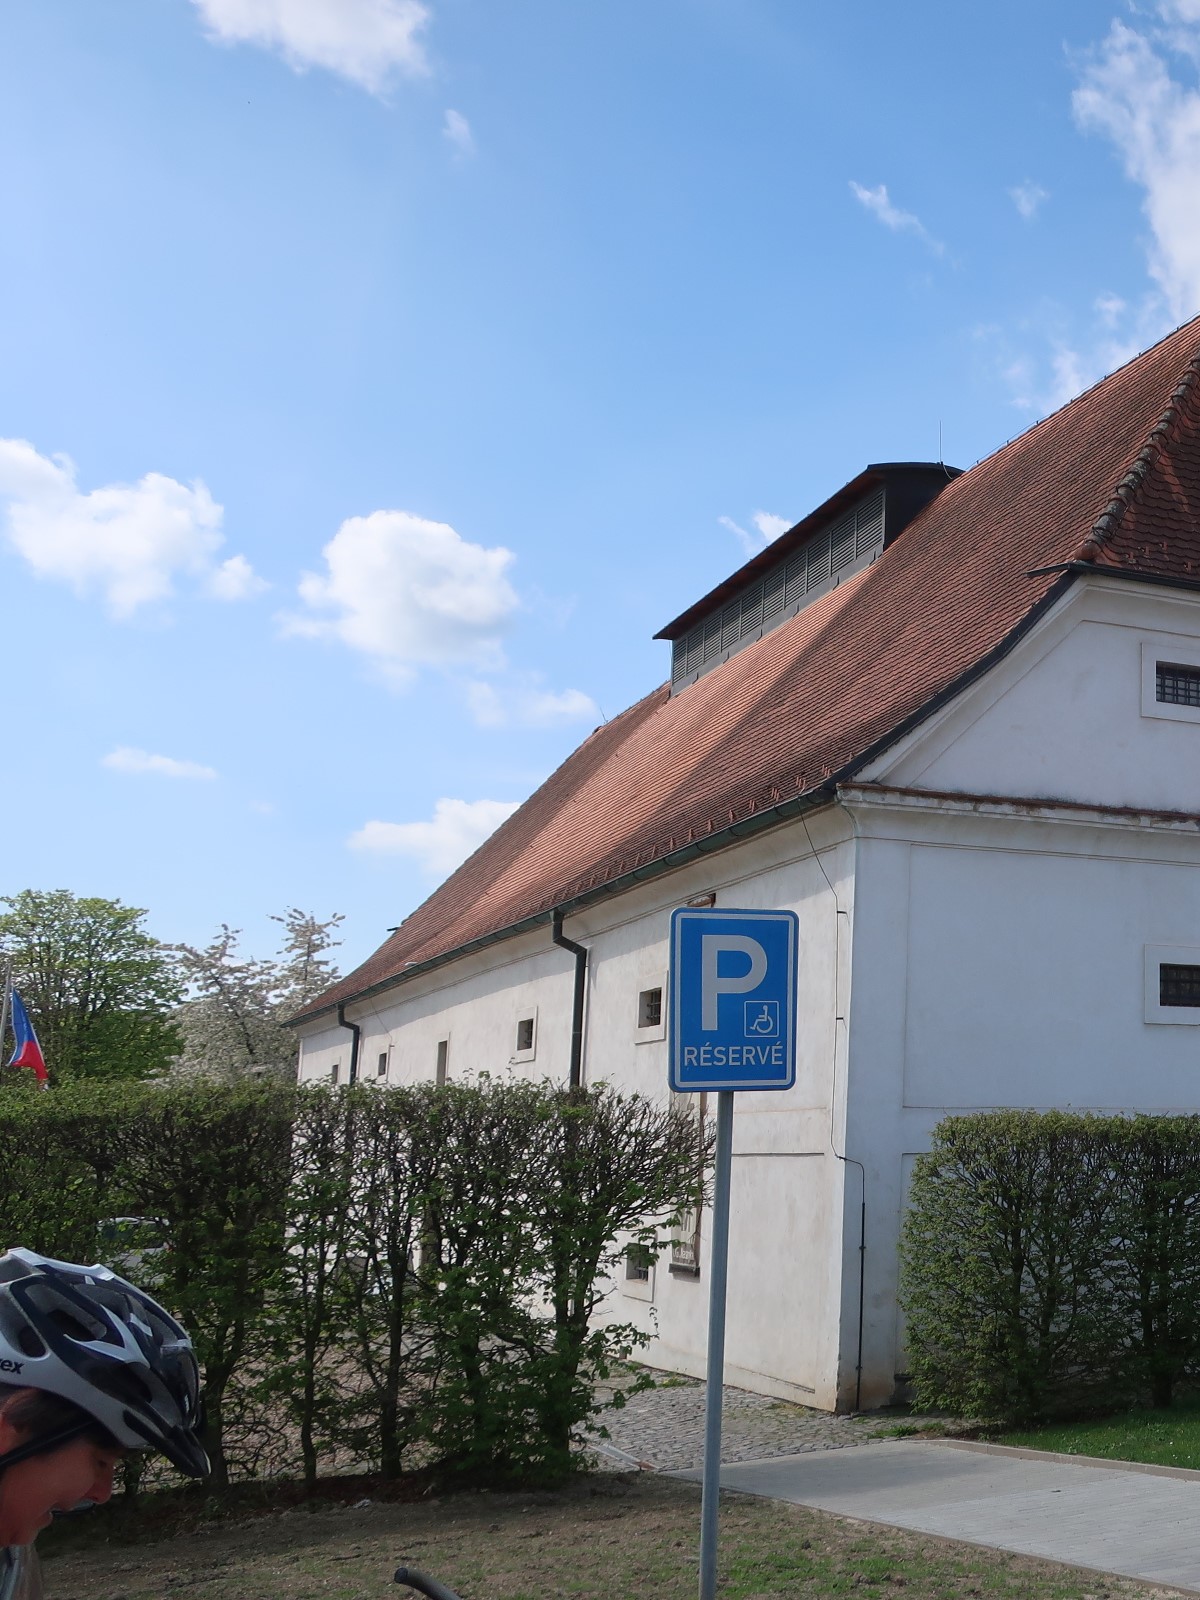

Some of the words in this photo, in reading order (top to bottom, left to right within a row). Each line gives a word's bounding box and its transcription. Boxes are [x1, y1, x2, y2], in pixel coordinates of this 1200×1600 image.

[702, 934, 768, 1031] P
[684, 1040, 784, 1067] RÉSERVÉ
[0, 1359, 25, 1375] ex
